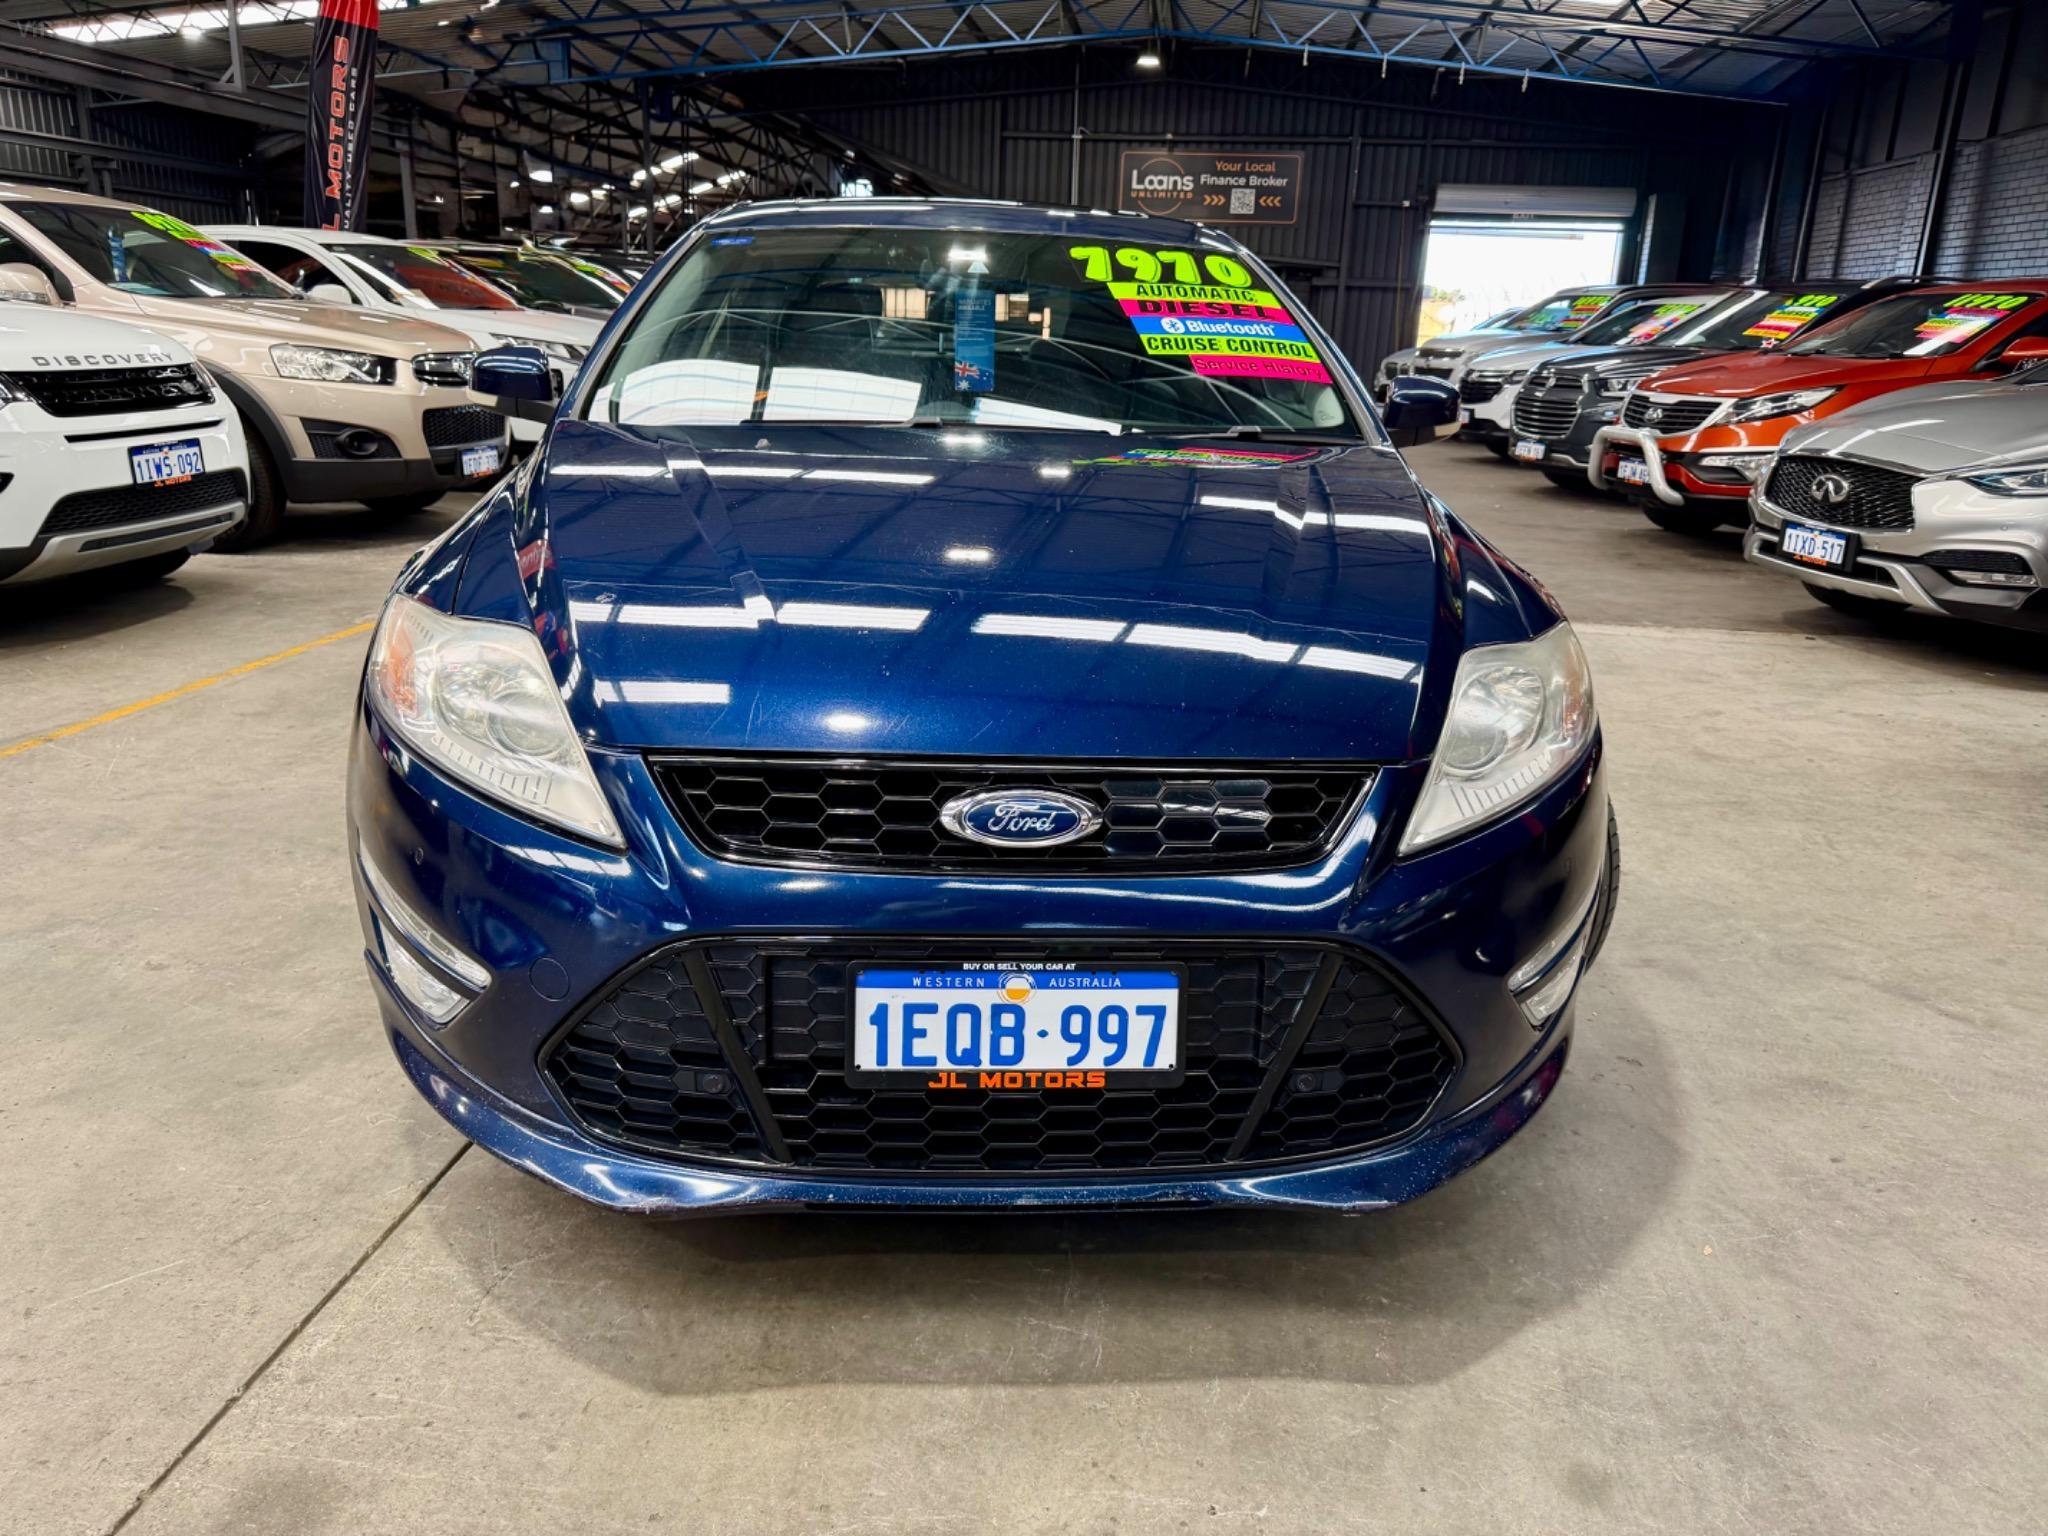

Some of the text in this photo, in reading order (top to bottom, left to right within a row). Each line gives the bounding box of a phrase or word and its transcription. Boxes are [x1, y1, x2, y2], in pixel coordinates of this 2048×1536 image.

[325, 35, 350, 200] MOTORS
[1215, 160, 1276, 173] Your Local
[1131, 169, 1194, 191] Loans
[1200, 174, 1289, 187] Finance Broker
[343, 171, 353, 229] UALITY
[1131, 191, 1193, 199] UNLIMITED
[1070, 246, 1253, 288] 7970
[1136, 284, 1256, 302] AUTOMATIC
[1138, 300, 1276, 319] DIESEL
[1147, 336, 1313, 358] CRUISE CONTROL
[32, 352, 175, 367] DISCOVERY
[1195, 358, 1323, 379] Service History
[987, 804, 1056, 832] Ford
[997, 962, 1018, 970] SELL
[912, 976, 1122, 988] WESTERN AUSTRALIA
[928, 1071, 1106, 1089] JL MOTORS
